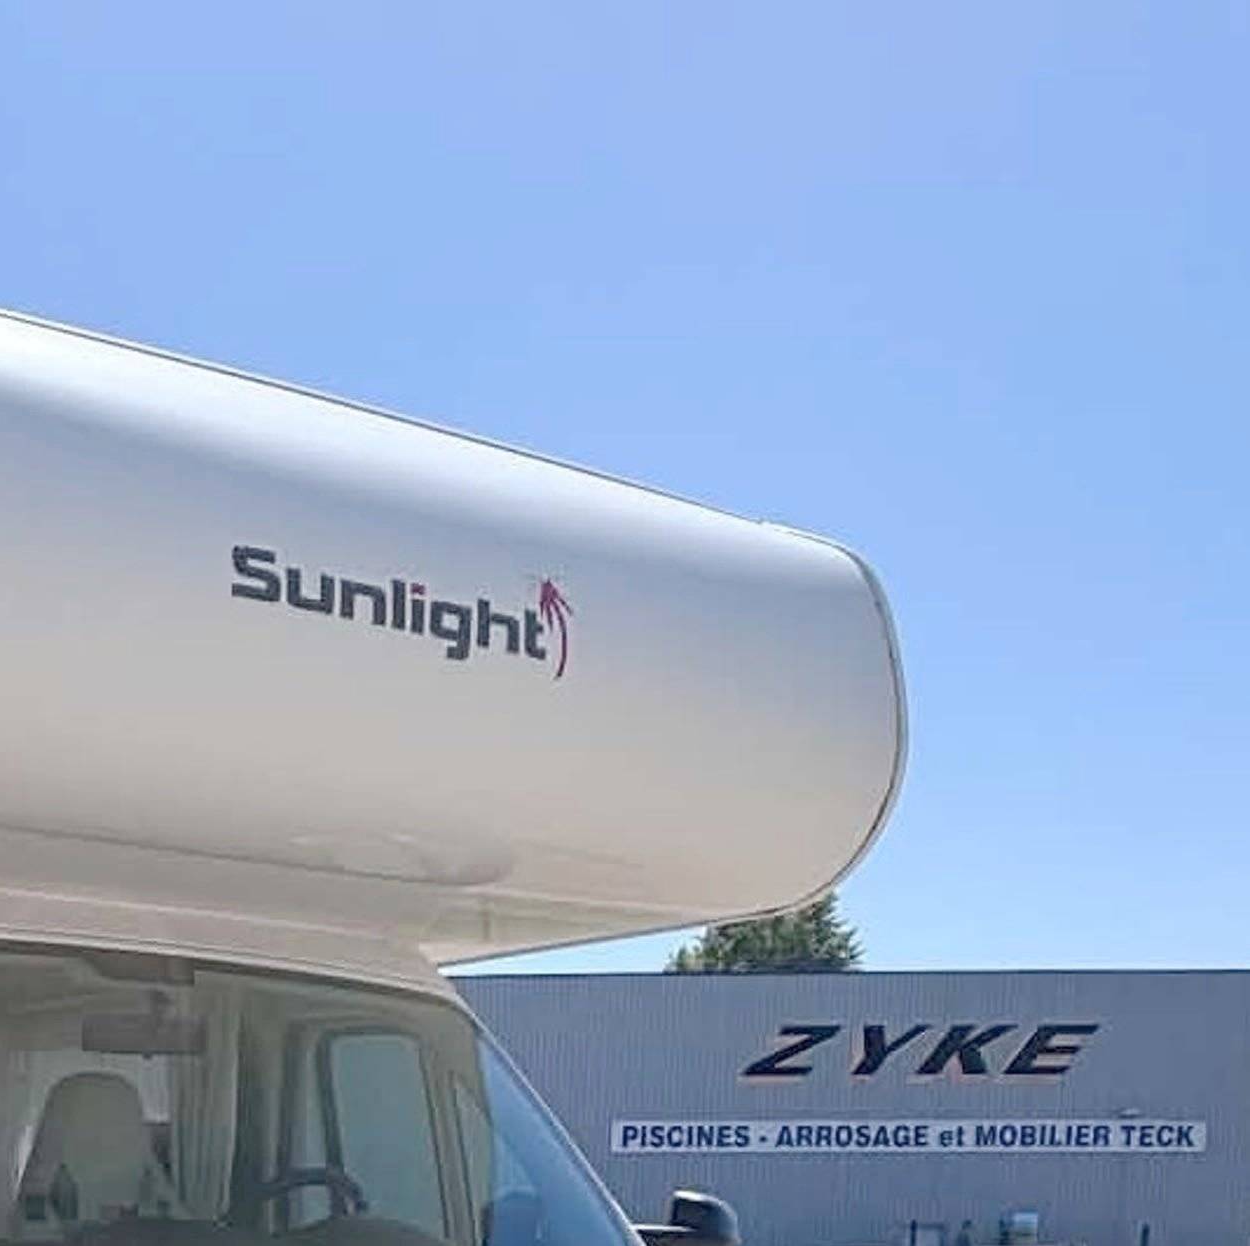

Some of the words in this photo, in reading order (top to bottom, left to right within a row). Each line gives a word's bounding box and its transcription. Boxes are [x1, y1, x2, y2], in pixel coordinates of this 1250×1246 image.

[231, 544, 547, 661] Sunlight
[740, 1023, 1101, 1077] ZYKE
[620, 1124, 751, 1149] PISCINES
[774, 1124, 929, 1149] ARROSAGE
[938, 1124, 966, 1149] et
[974, 1123, 1111, 1149] MOBILIER
[1121, 1124, 1196, 1149] TECK
